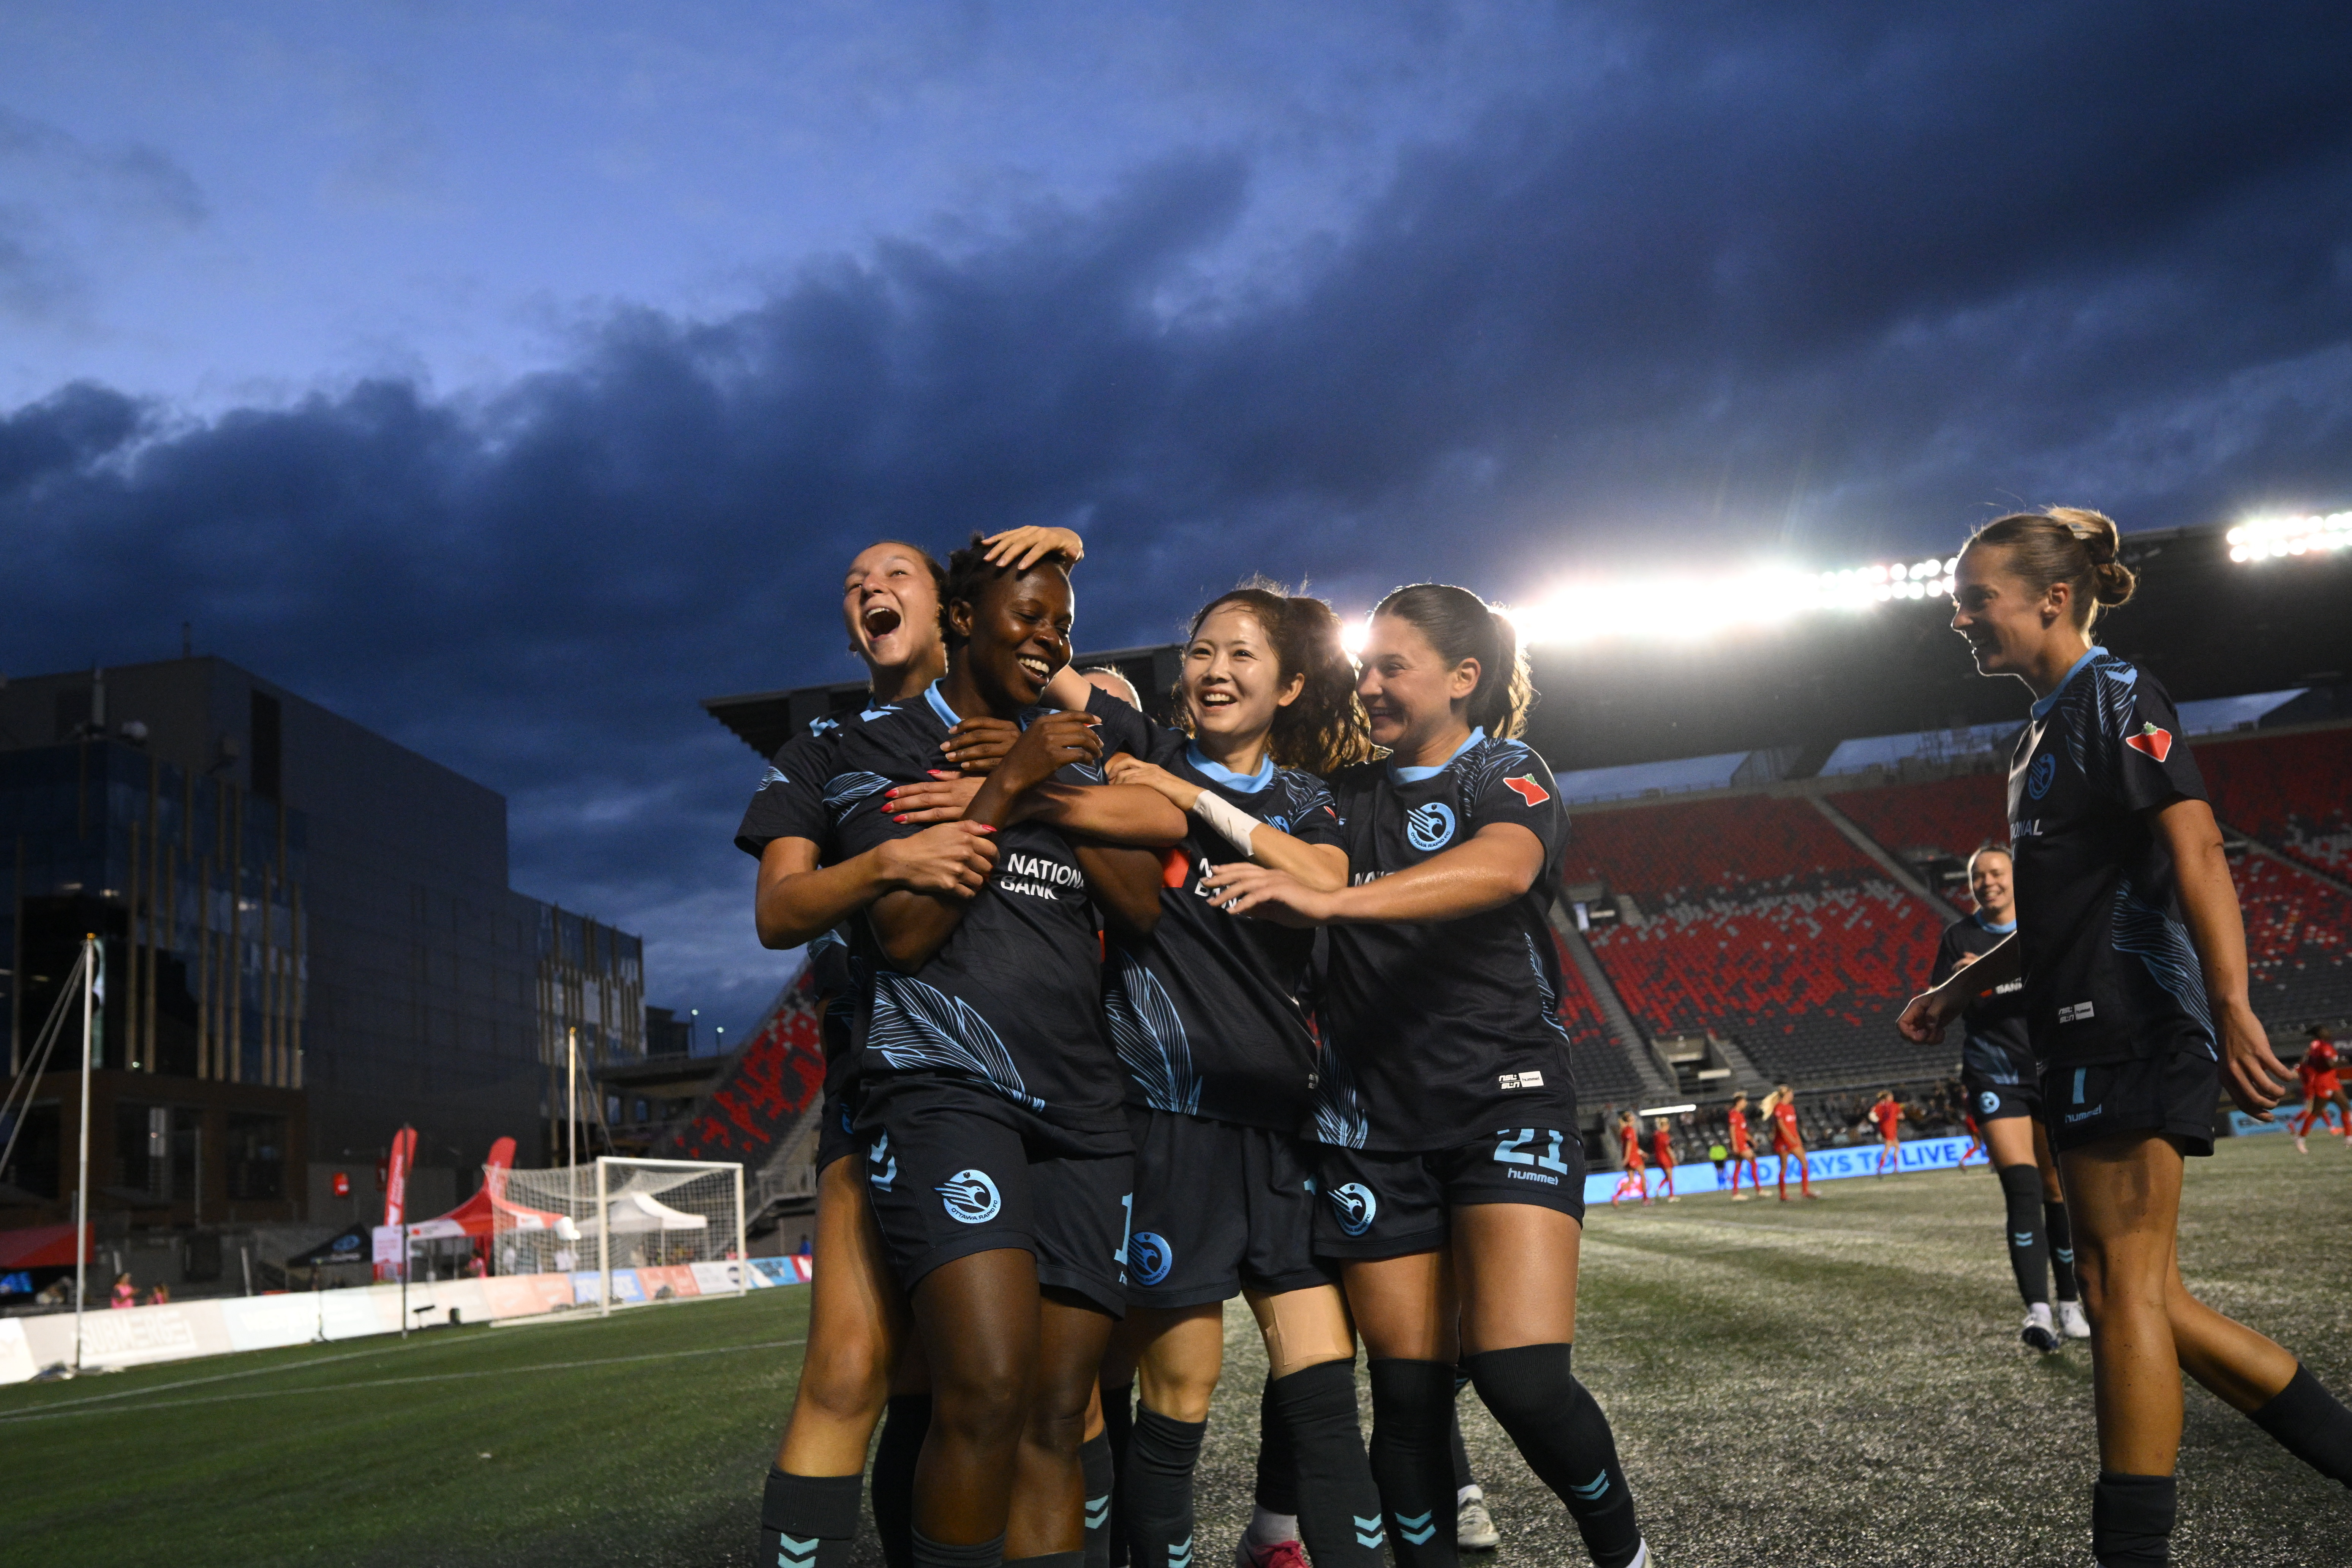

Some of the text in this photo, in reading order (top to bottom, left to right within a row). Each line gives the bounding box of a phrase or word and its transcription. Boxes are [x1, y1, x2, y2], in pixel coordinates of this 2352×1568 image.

[1411, 832, 1427, 847] OTTAWA
[1428, 839, 1445, 848] RAPID
[2065, 1103, 2102, 1123] hummel
[1494, 1129, 1568, 1175] 21
[1902, 1144, 1958, 1165] LIVE
[1507, 1168, 1559, 1185] hummel
[952, 1208, 978, 1220] OTTAWA
[978, 1208, 995, 1220] RAPID
